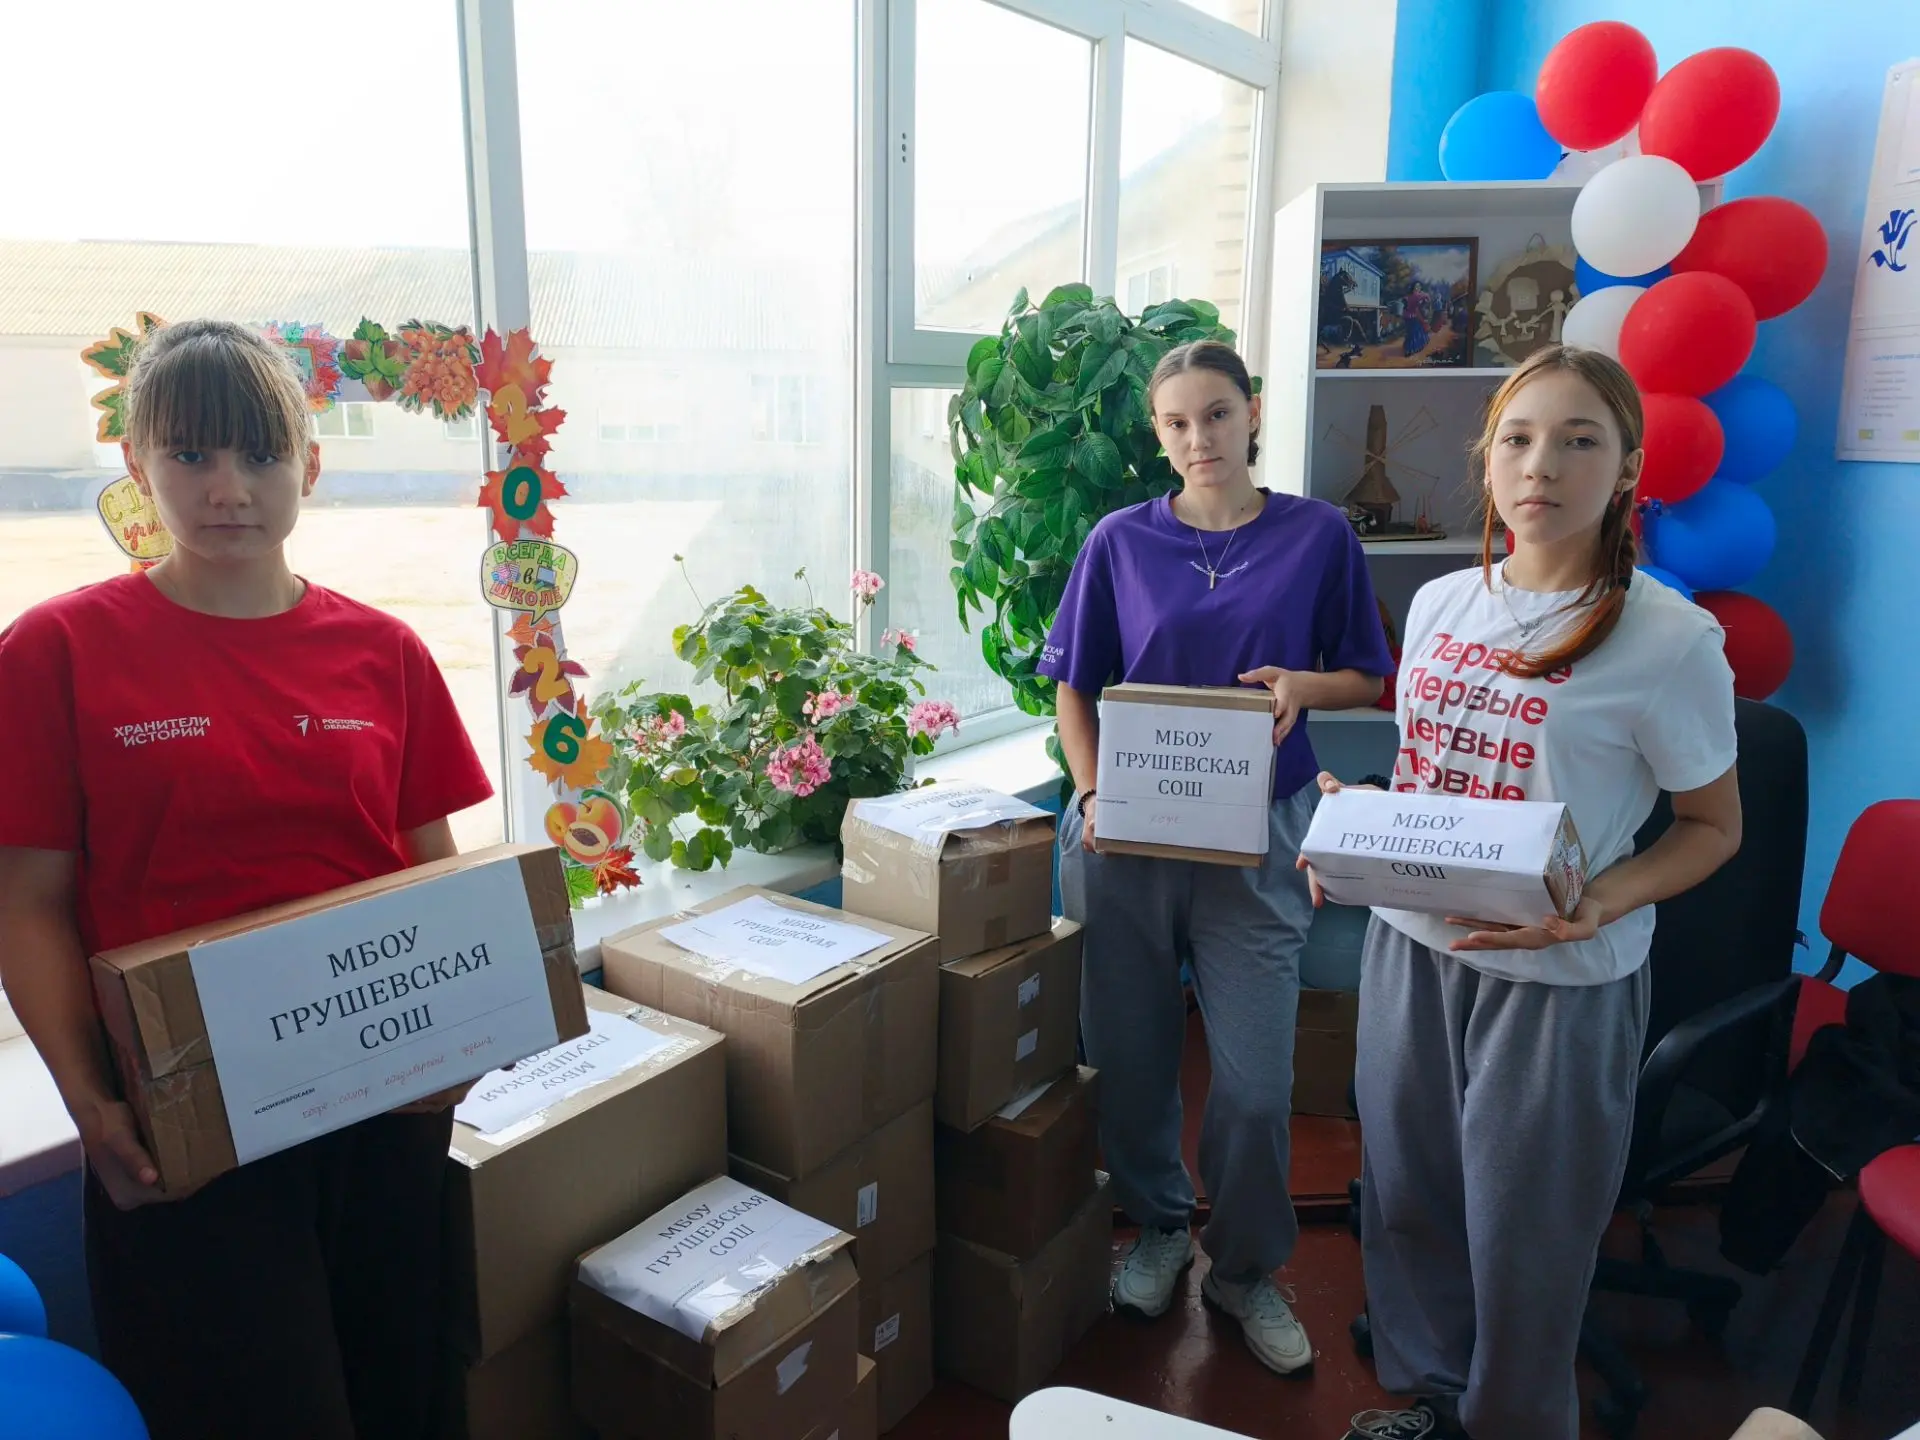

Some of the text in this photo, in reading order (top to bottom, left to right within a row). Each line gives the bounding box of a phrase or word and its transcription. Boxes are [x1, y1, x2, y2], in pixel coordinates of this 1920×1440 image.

[493, 541, 567, 571] ВСЕГДА
[523, 567, 534, 584] в
[489, 580, 563, 607] ШКОЛЕ
[1405, 667, 1548, 725] Первые
[113, 716, 211, 738] ХРАНИТЕЛИ
[123, 727, 206, 747] ИСТОРИИ
[1155, 729, 1213, 748] МБОУ
[1115, 751, 1250, 776] ГРУШЕВСКАЯ
[1158, 779, 1203, 798] СОШ
[1392, 812, 1465, 831] МБОУ
[1338, 832, 1505, 862] ГРУШЕВСКАЯ
[1390, 861, 1447, 880] СОШ
[733, 918, 837, 949] ГРУШЕВСКАЯ
[777, 917, 827, 931] МБОУ
[327, 925, 419, 979] МБОУ
[748, 935, 788, 947] СОШ
[269, 943, 493, 1042] ГРУШЕВСКАЯ
[359, 1003, 434, 1050] СОШ
[478, 1033, 611, 1103] ГРУШЕВСКАЯ
[543, 1060, 597, 1090] МБОУ
[645, 1194, 769, 1275] ГРУШЕВСКАЯ
[658, 1203, 712, 1240] МБОУ
[709, 1223, 757, 1257] СОШ
